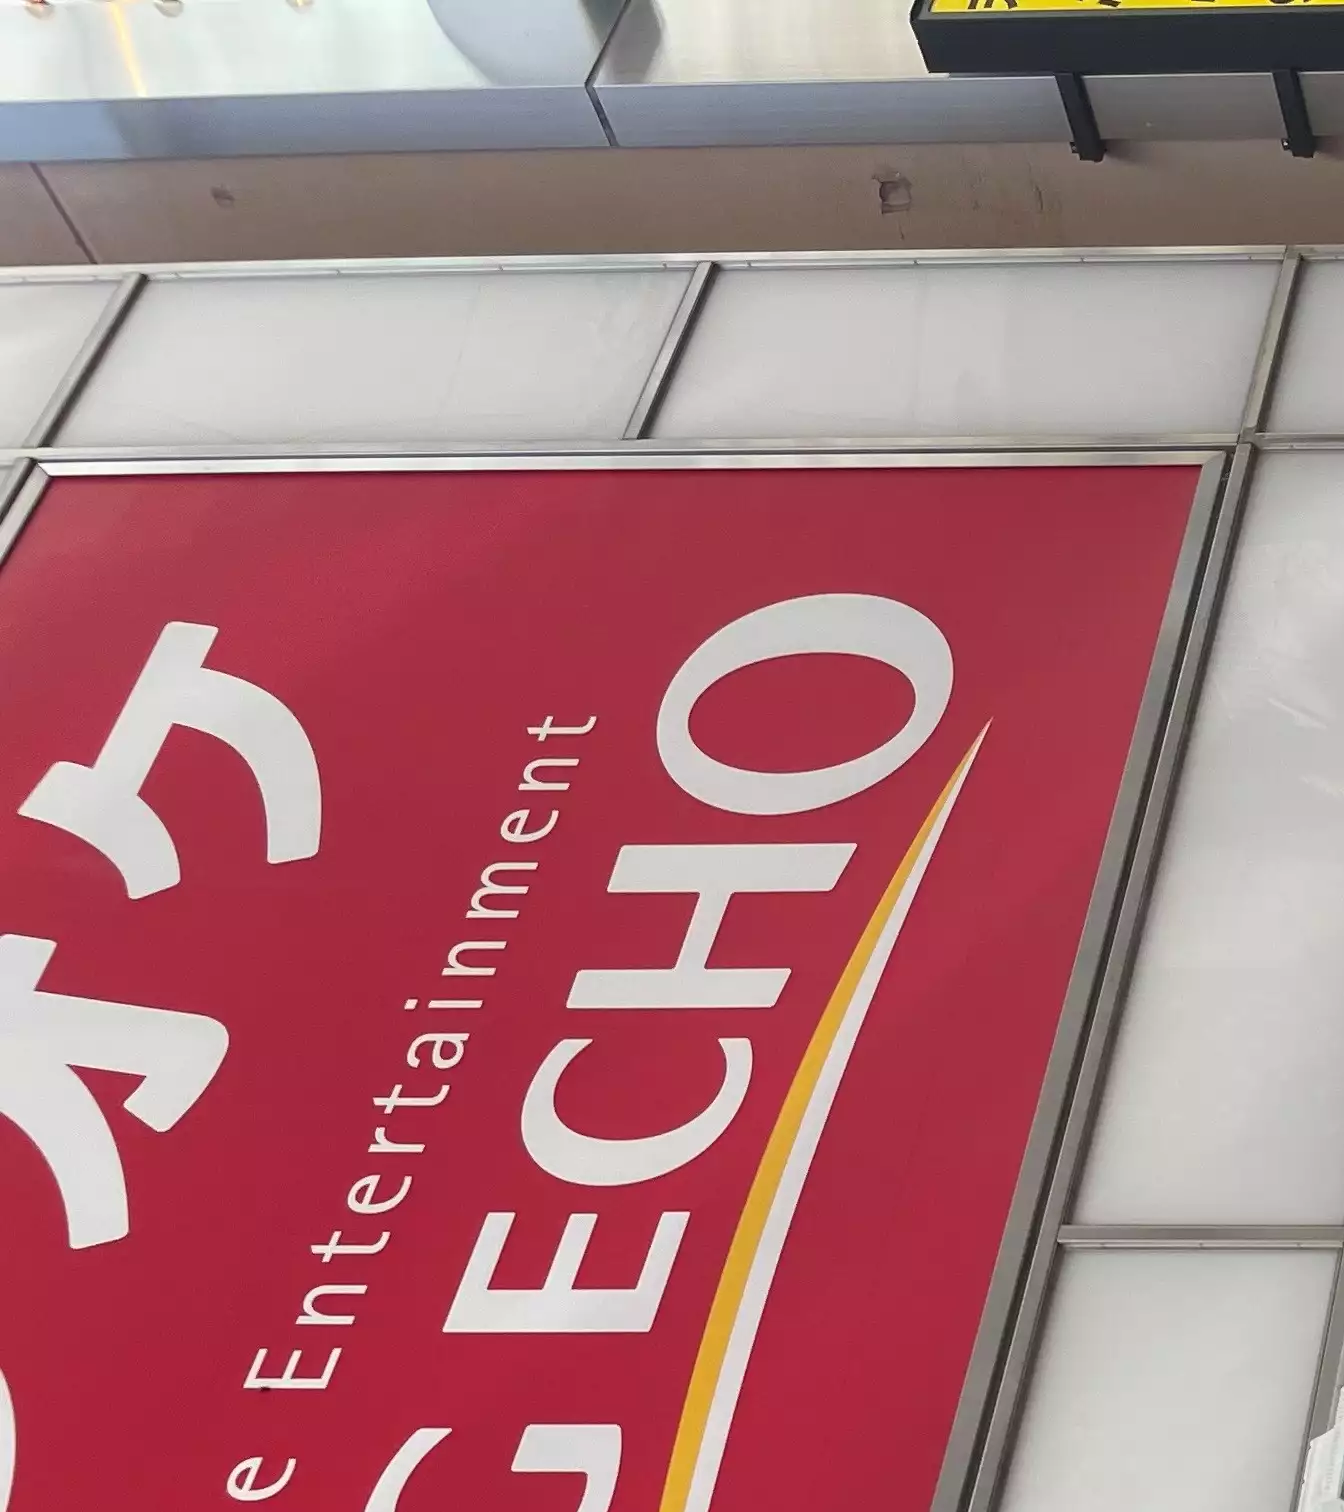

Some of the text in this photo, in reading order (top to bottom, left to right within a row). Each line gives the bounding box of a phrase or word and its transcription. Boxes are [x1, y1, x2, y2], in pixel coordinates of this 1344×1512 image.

[0, 621, 322, 1489] オケ
[242, 710, 599, 1390] Entertainment
[441, 593, 955, 1334] ECHO
